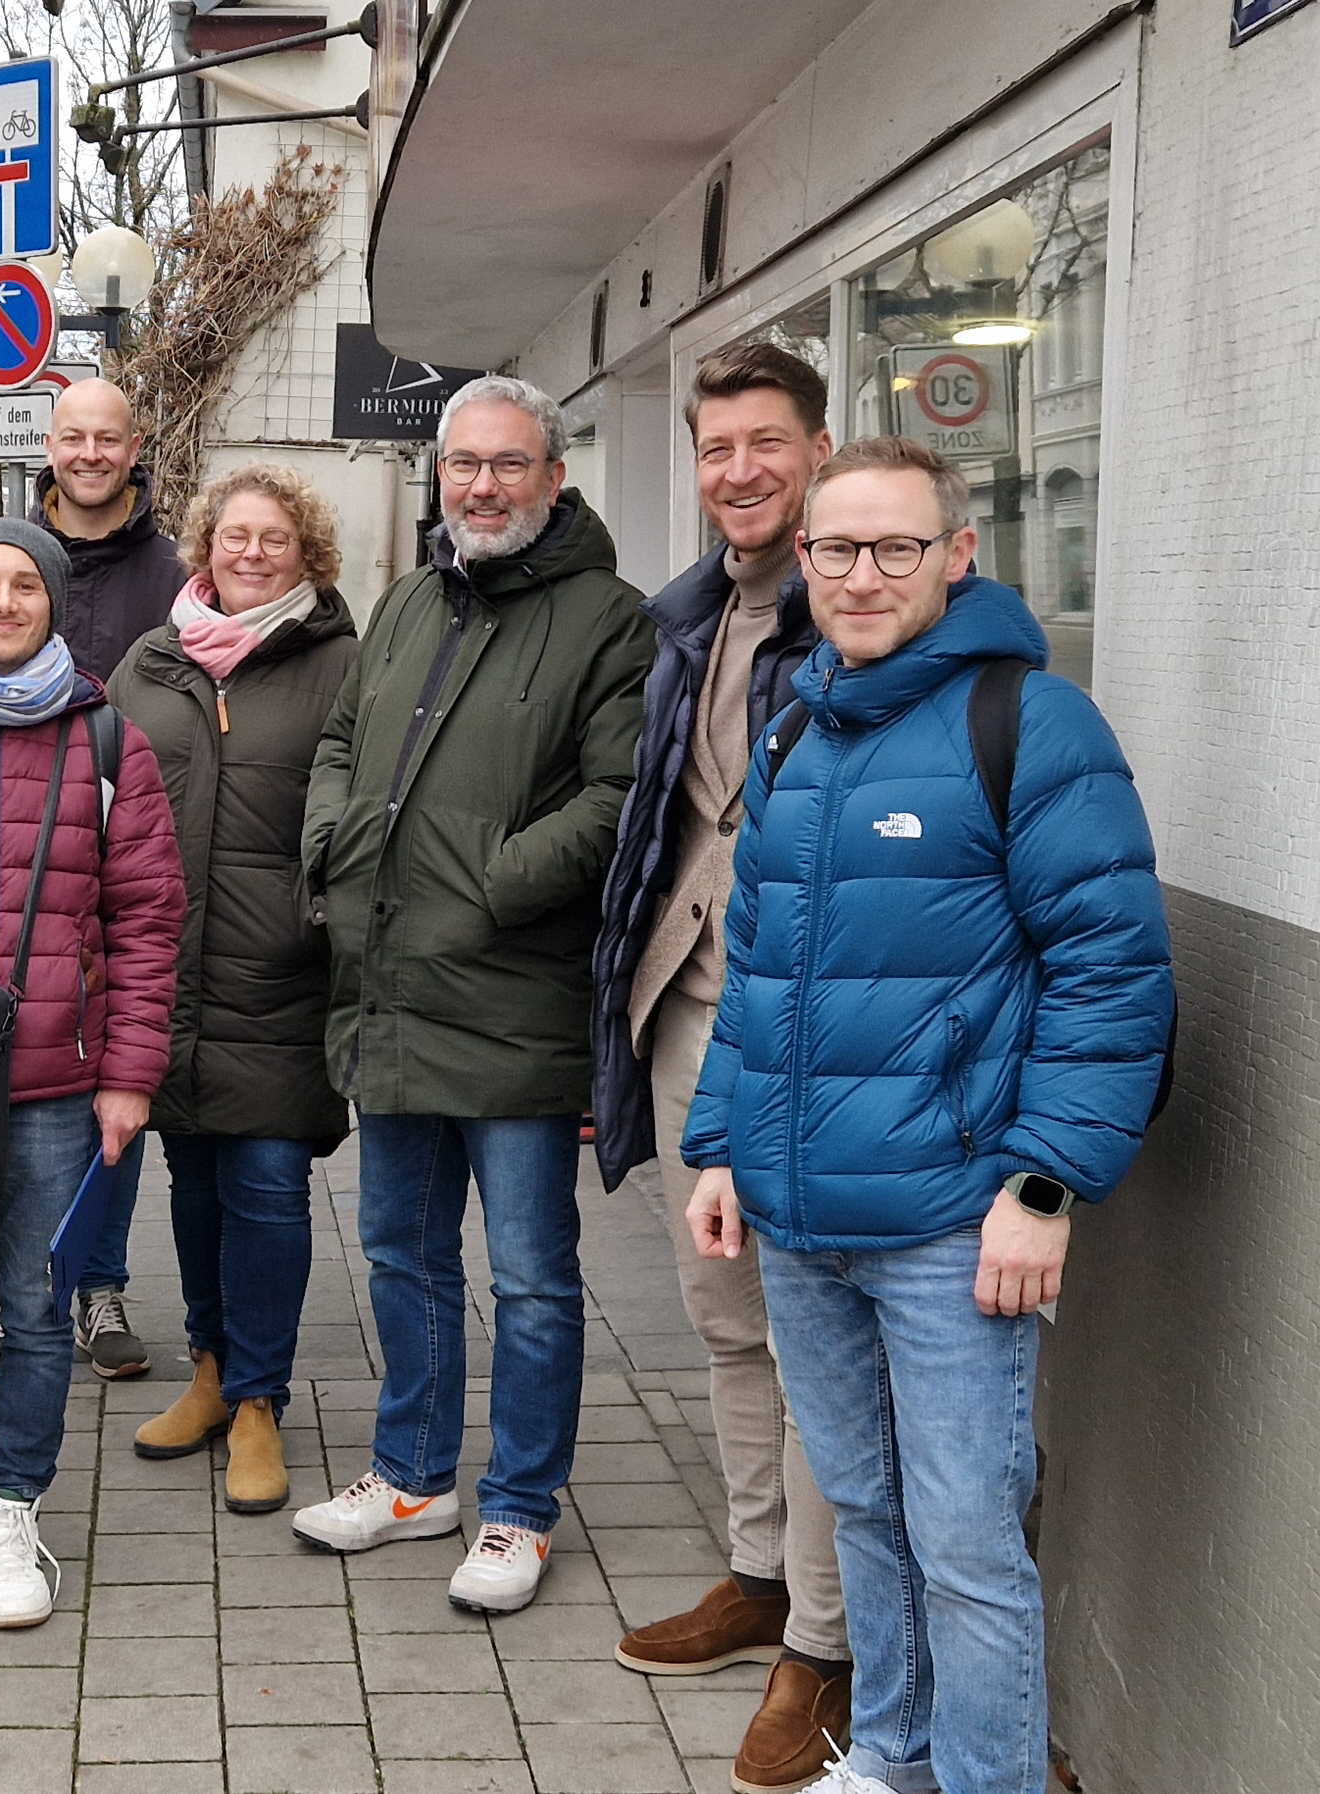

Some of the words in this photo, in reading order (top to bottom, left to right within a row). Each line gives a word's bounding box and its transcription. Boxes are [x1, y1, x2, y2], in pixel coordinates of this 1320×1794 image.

[361, 398, 447, 415] BERMUD
[7, 406, 31, 423] dem
[396, 417, 421, 426] BAR
[887, 812, 907, 821] THE
[872, 820, 905, 830] NORTH
[880, 829, 905, 838] FACE
